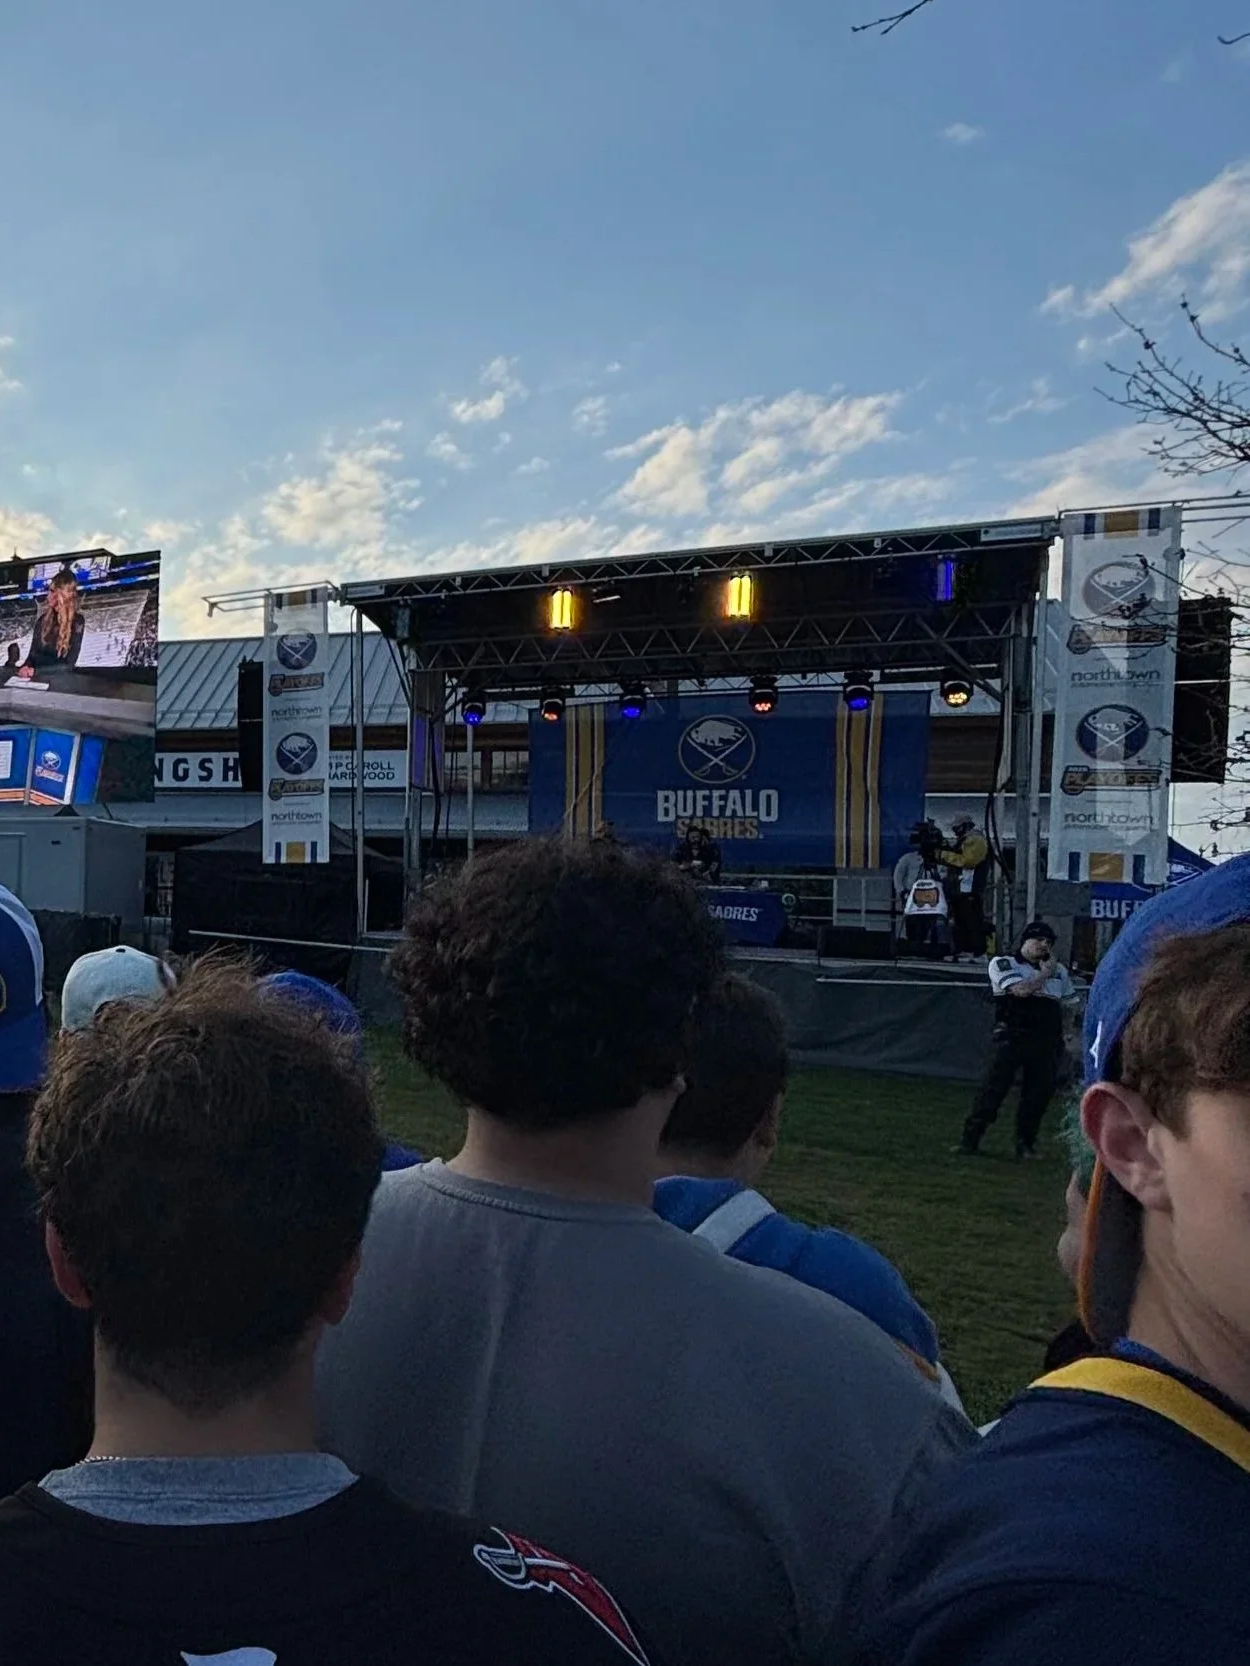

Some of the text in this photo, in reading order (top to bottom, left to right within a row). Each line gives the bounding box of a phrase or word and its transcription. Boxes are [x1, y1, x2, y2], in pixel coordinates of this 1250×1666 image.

[1071, 668, 1160, 681] northtown
[271, 705, 322, 717] northtown
[346, 762, 394, 770] CROLL
[657, 789, 778, 822] BUFFALO
[271, 811, 322, 820] northtown
[1064, 812, 1153, 824] northtown
